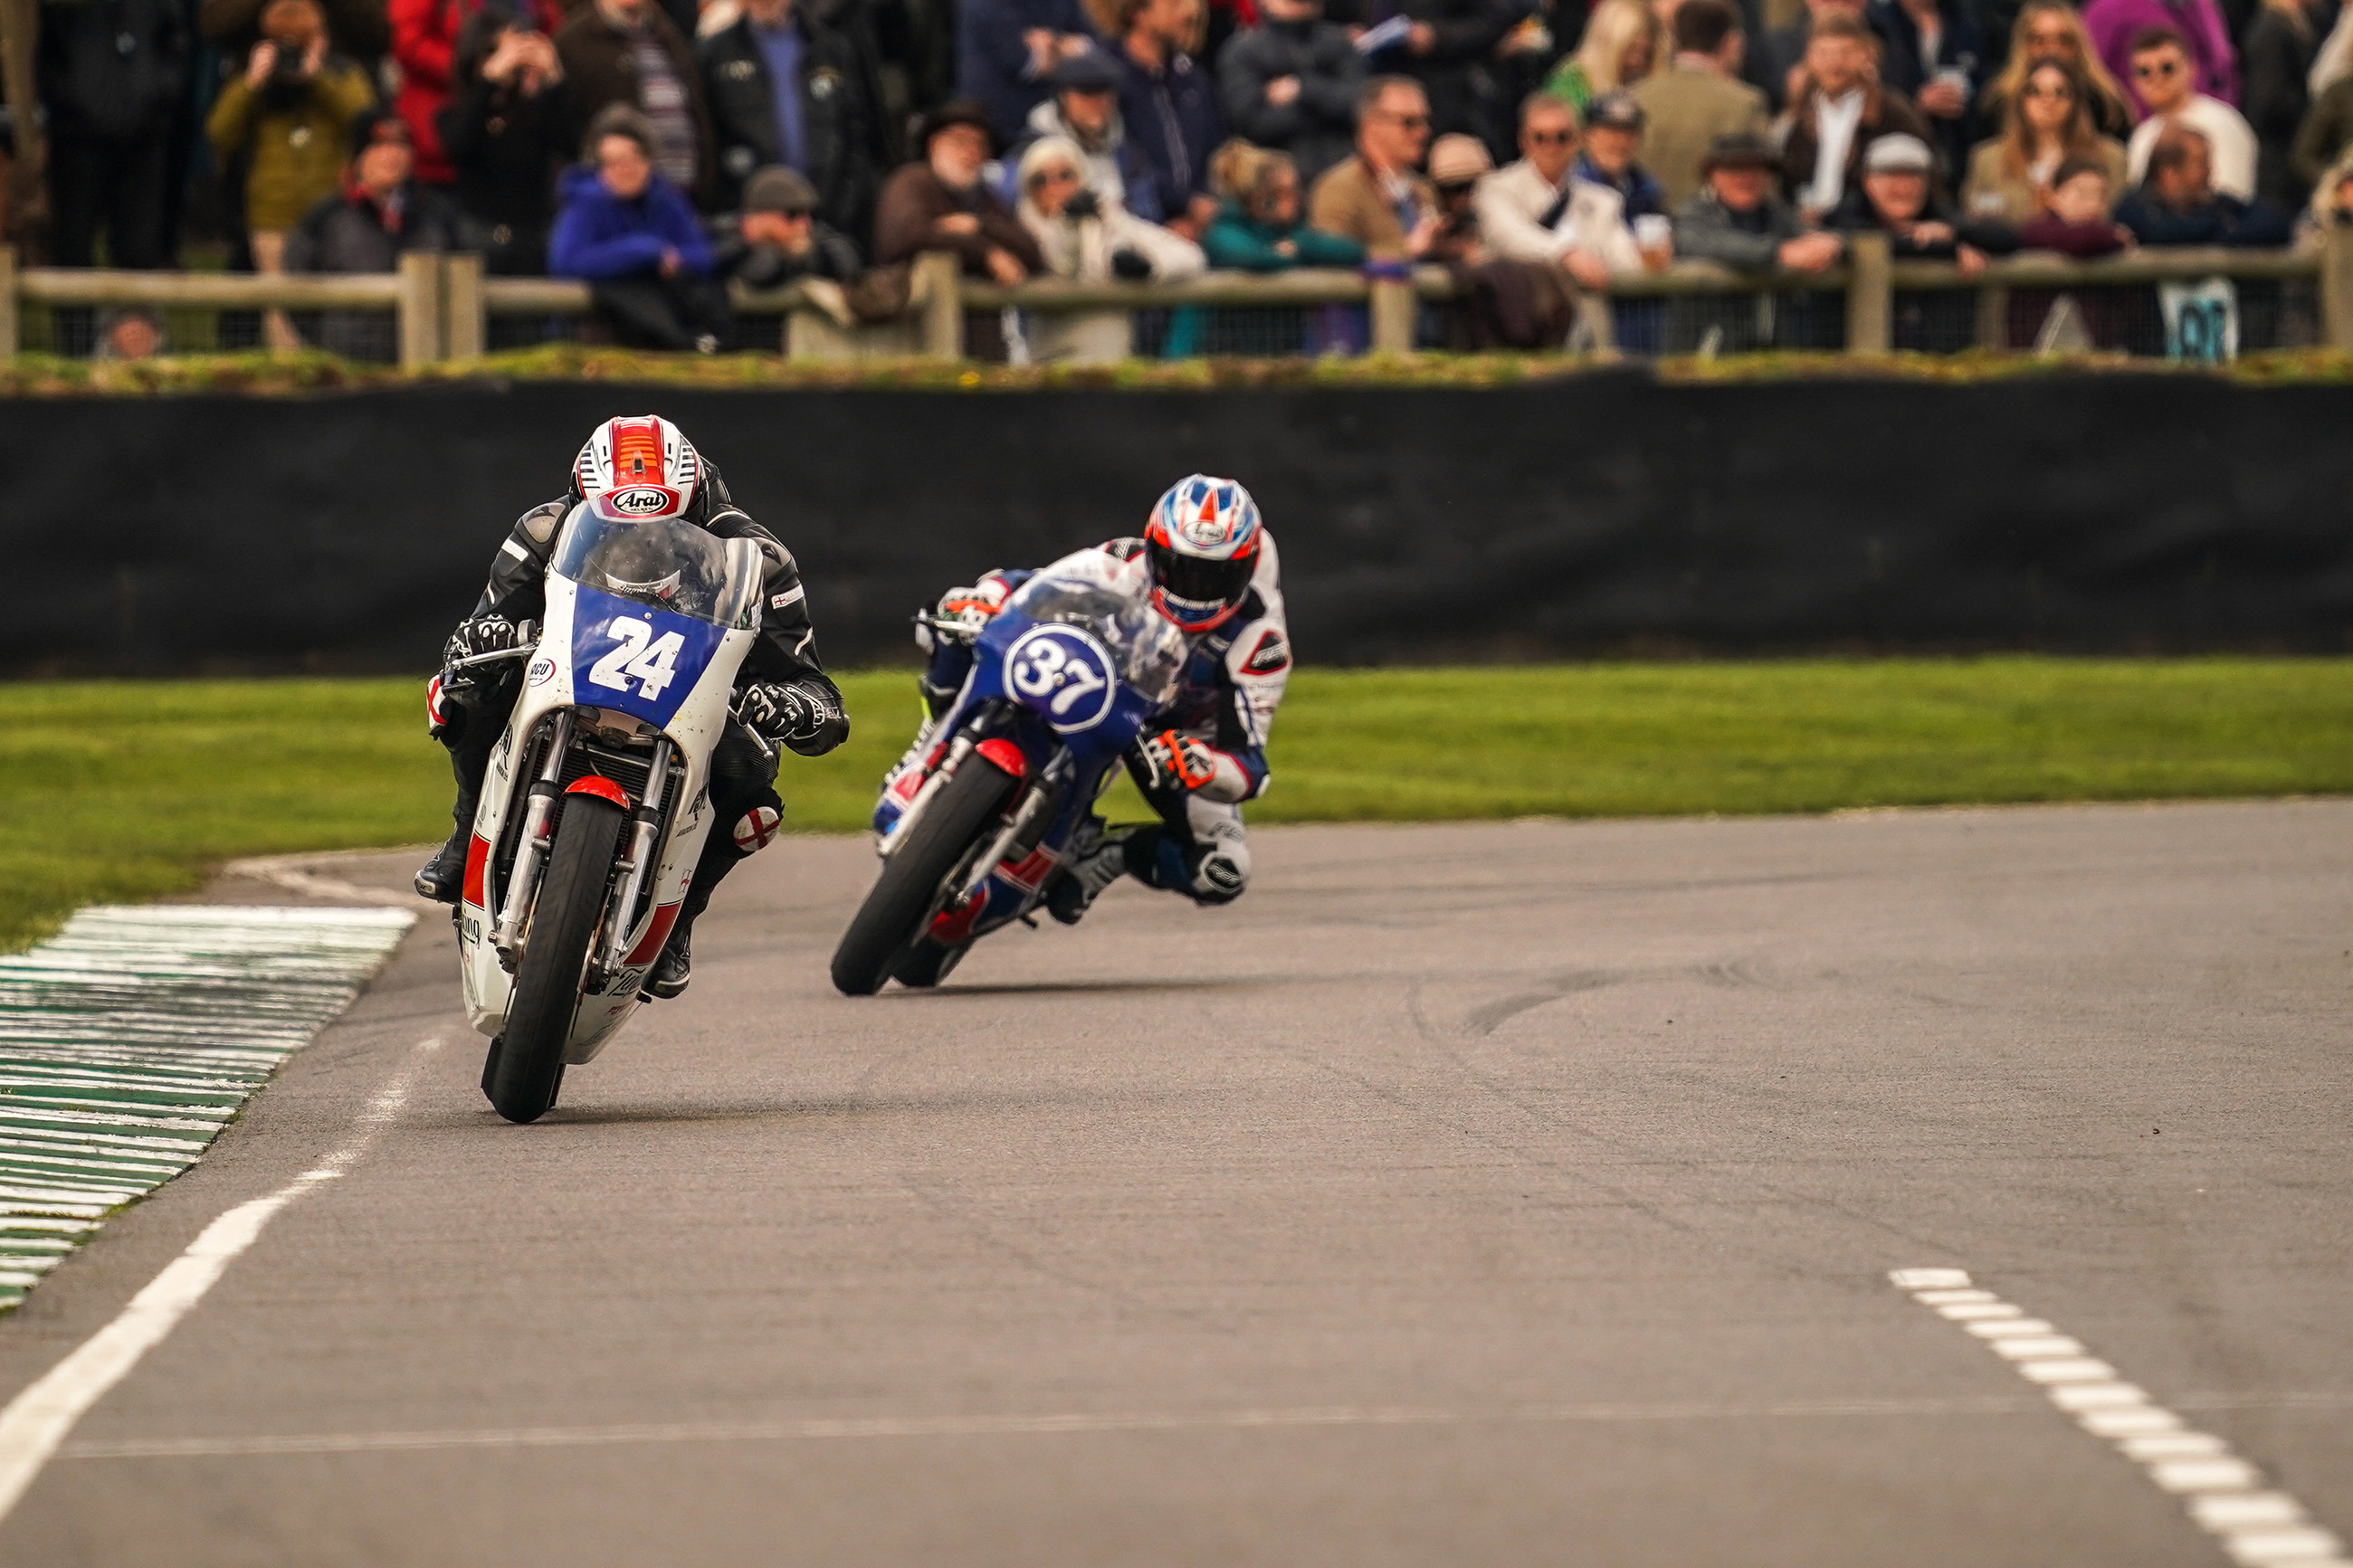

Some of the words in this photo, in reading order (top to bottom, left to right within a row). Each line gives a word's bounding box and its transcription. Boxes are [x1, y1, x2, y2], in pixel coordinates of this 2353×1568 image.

[617, 492, 662, 508] Arai
[529, 662, 550, 676] ACU
[588, 615, 686, 701] 24
[1013, 637, 1106, 715] 37
